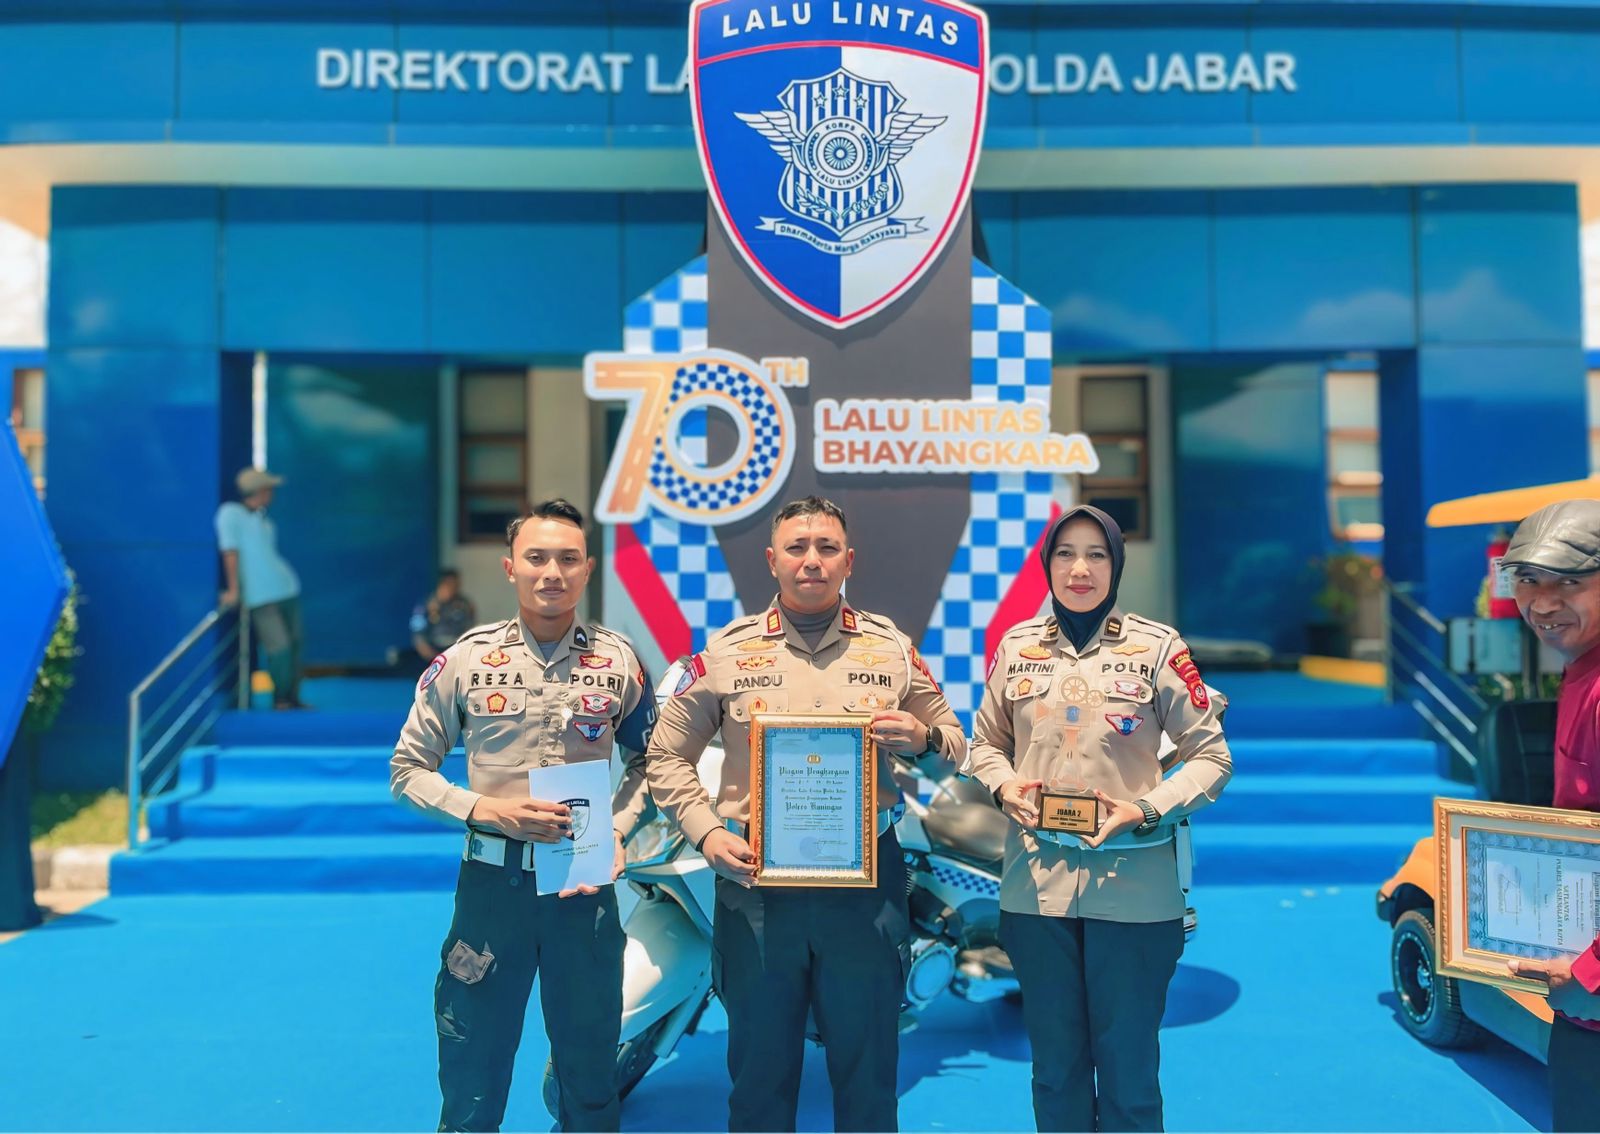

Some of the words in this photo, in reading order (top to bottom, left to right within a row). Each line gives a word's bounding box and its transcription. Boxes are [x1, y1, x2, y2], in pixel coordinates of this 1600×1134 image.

[722, 2, 812, 38] LALU
[832, 1, 959, 46] LINTAS
[316, 49, 632, 93] DIREKTORAT
[988, 54, 1123, 93] OLDA
[1132, 53, 1297, 92] JABAR
[825, 122, 856, 131] KORPS
[816, 170, 835, 185] LALU
[837, 171, 865, 186] LINTAS
[763, 361, 806, 385] TH
[822, 408, 911, 433] LALU
[922, 408, 1043, 433] LINTAS
[822, 440, 1091, 465] BHAYANGKARA
[1007, 662, 1056, 674] MARTINI
[1101, 662, 1155, 679] POLRI
[471, 672, 524, 686] REZA
[570, 673, 622, 691] POLRI
[734, 674, 783, 691] PANDU
[848, 672, 892, 688] POLRI
[1056, 808, 1076, 817] JUARA
